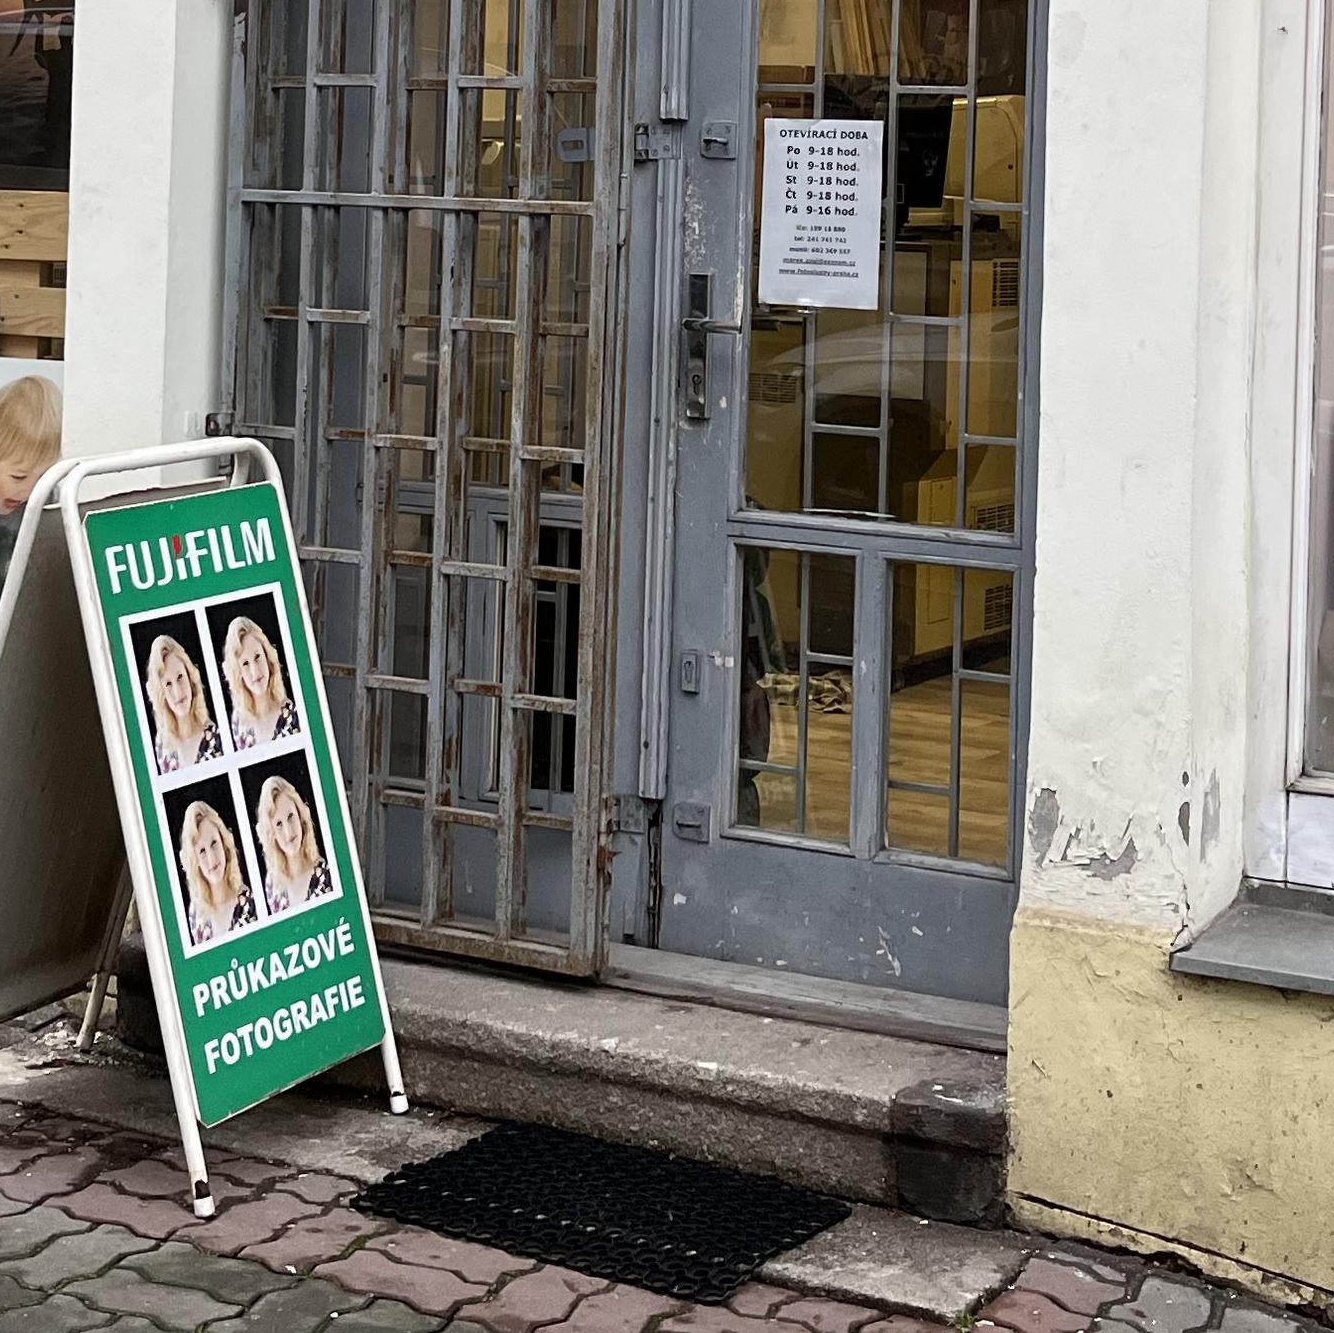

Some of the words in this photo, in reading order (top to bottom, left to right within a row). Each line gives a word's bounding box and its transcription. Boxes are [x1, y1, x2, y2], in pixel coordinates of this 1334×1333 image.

[779, 128, 837, 140] OTEVÍRACÍ
[840, 131, 869, 140] DOBA
[786, 146, 801, 155] Po
[808, 147, 834, 156] 9-18
[837, 147, 860, 157] hod.
[786, 158, 799, 170] Út
[807, 161, 833, 171] 9-18
[836, 162, 860, 172] hod.
[785, 175, 797, 185] St
[807, 176, 832, 186] 9-18
[835, 176, 859, 187] hod.
[785, 187, 797, 200] Čt
[806, 191, 832, 201] 9-18
[835, 191, 858, 202] hod.
[785, 204, 798, 214] Pá
[806, 206, 832, 215] 9-16
[834, 206, 858, 217] hod.
[104, 517, 276, 595] FUJIFILM
[192, 916, 356, 1018] PRŮKAZOVÉ
[203, 974, 366, 1075] FOTOGRAFIE
